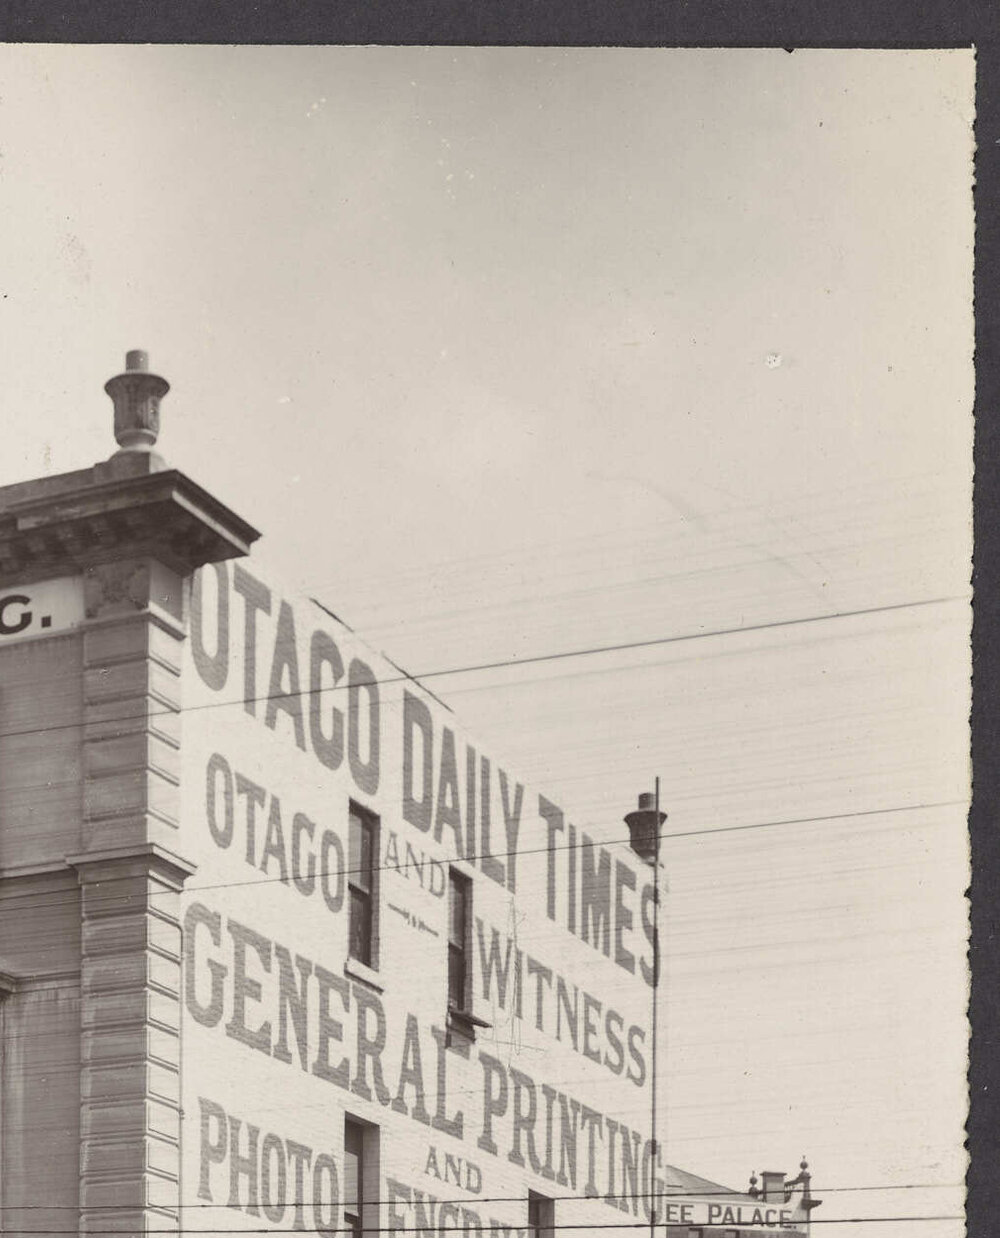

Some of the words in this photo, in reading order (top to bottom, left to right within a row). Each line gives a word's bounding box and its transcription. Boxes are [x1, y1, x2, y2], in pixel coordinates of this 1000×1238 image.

[190, 560, 381, 796] OTAGO
[402, 688, 525, 894] DAILY
[538, 793, 661, 988] TIMES
[206, 753, 345, 913] OTAGO
[384, 829, 446, 898] AND
[475, 916, 646, 1088] WITNESS
[183, 902, 470, 1140] GENERAL
[477, 1051, 664, 1225] PRINTING
[424, 1146, 483, 1194] AND
[708, 1203, 798, 1230] PALACE.
